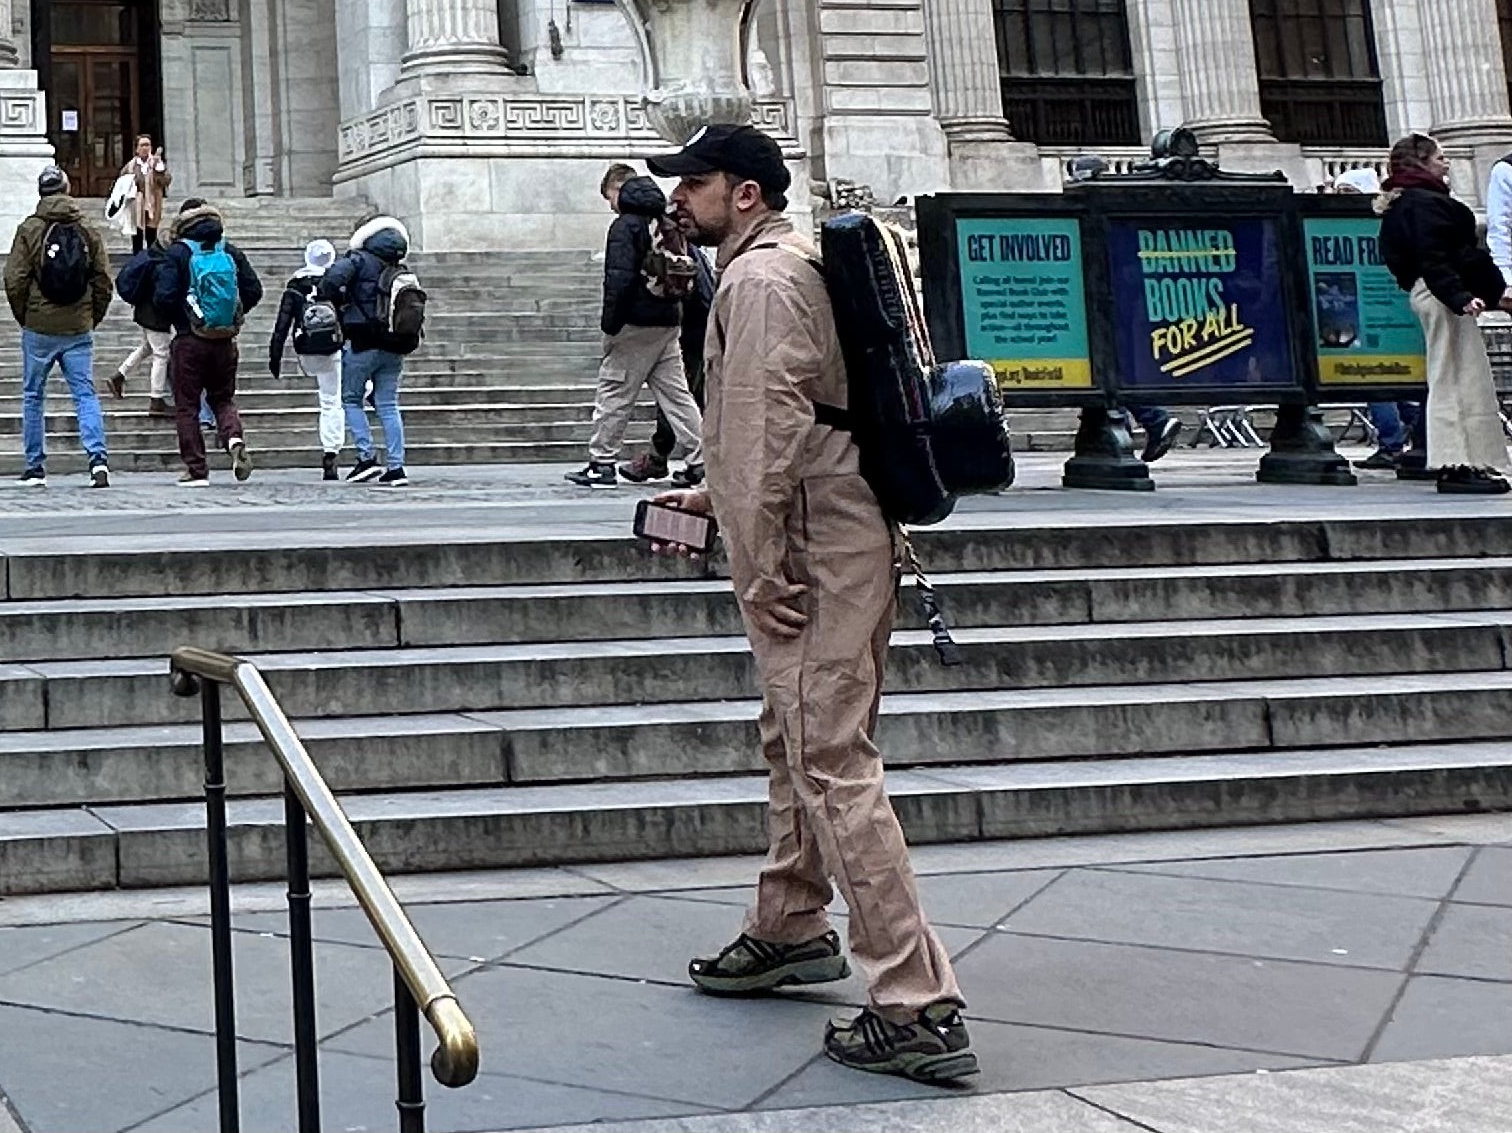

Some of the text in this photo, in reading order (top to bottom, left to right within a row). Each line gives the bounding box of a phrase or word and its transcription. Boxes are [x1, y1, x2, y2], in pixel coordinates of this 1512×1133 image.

[968, 234, 1071, 262] GET INVOLVED
[1138, 229, 1236, 273] BANNED
[1312, 236, 1354, 265] READ
[1144, 277, 1226, 323] BOOKS
[1151, 303, 1244, 359] FOR ALL
